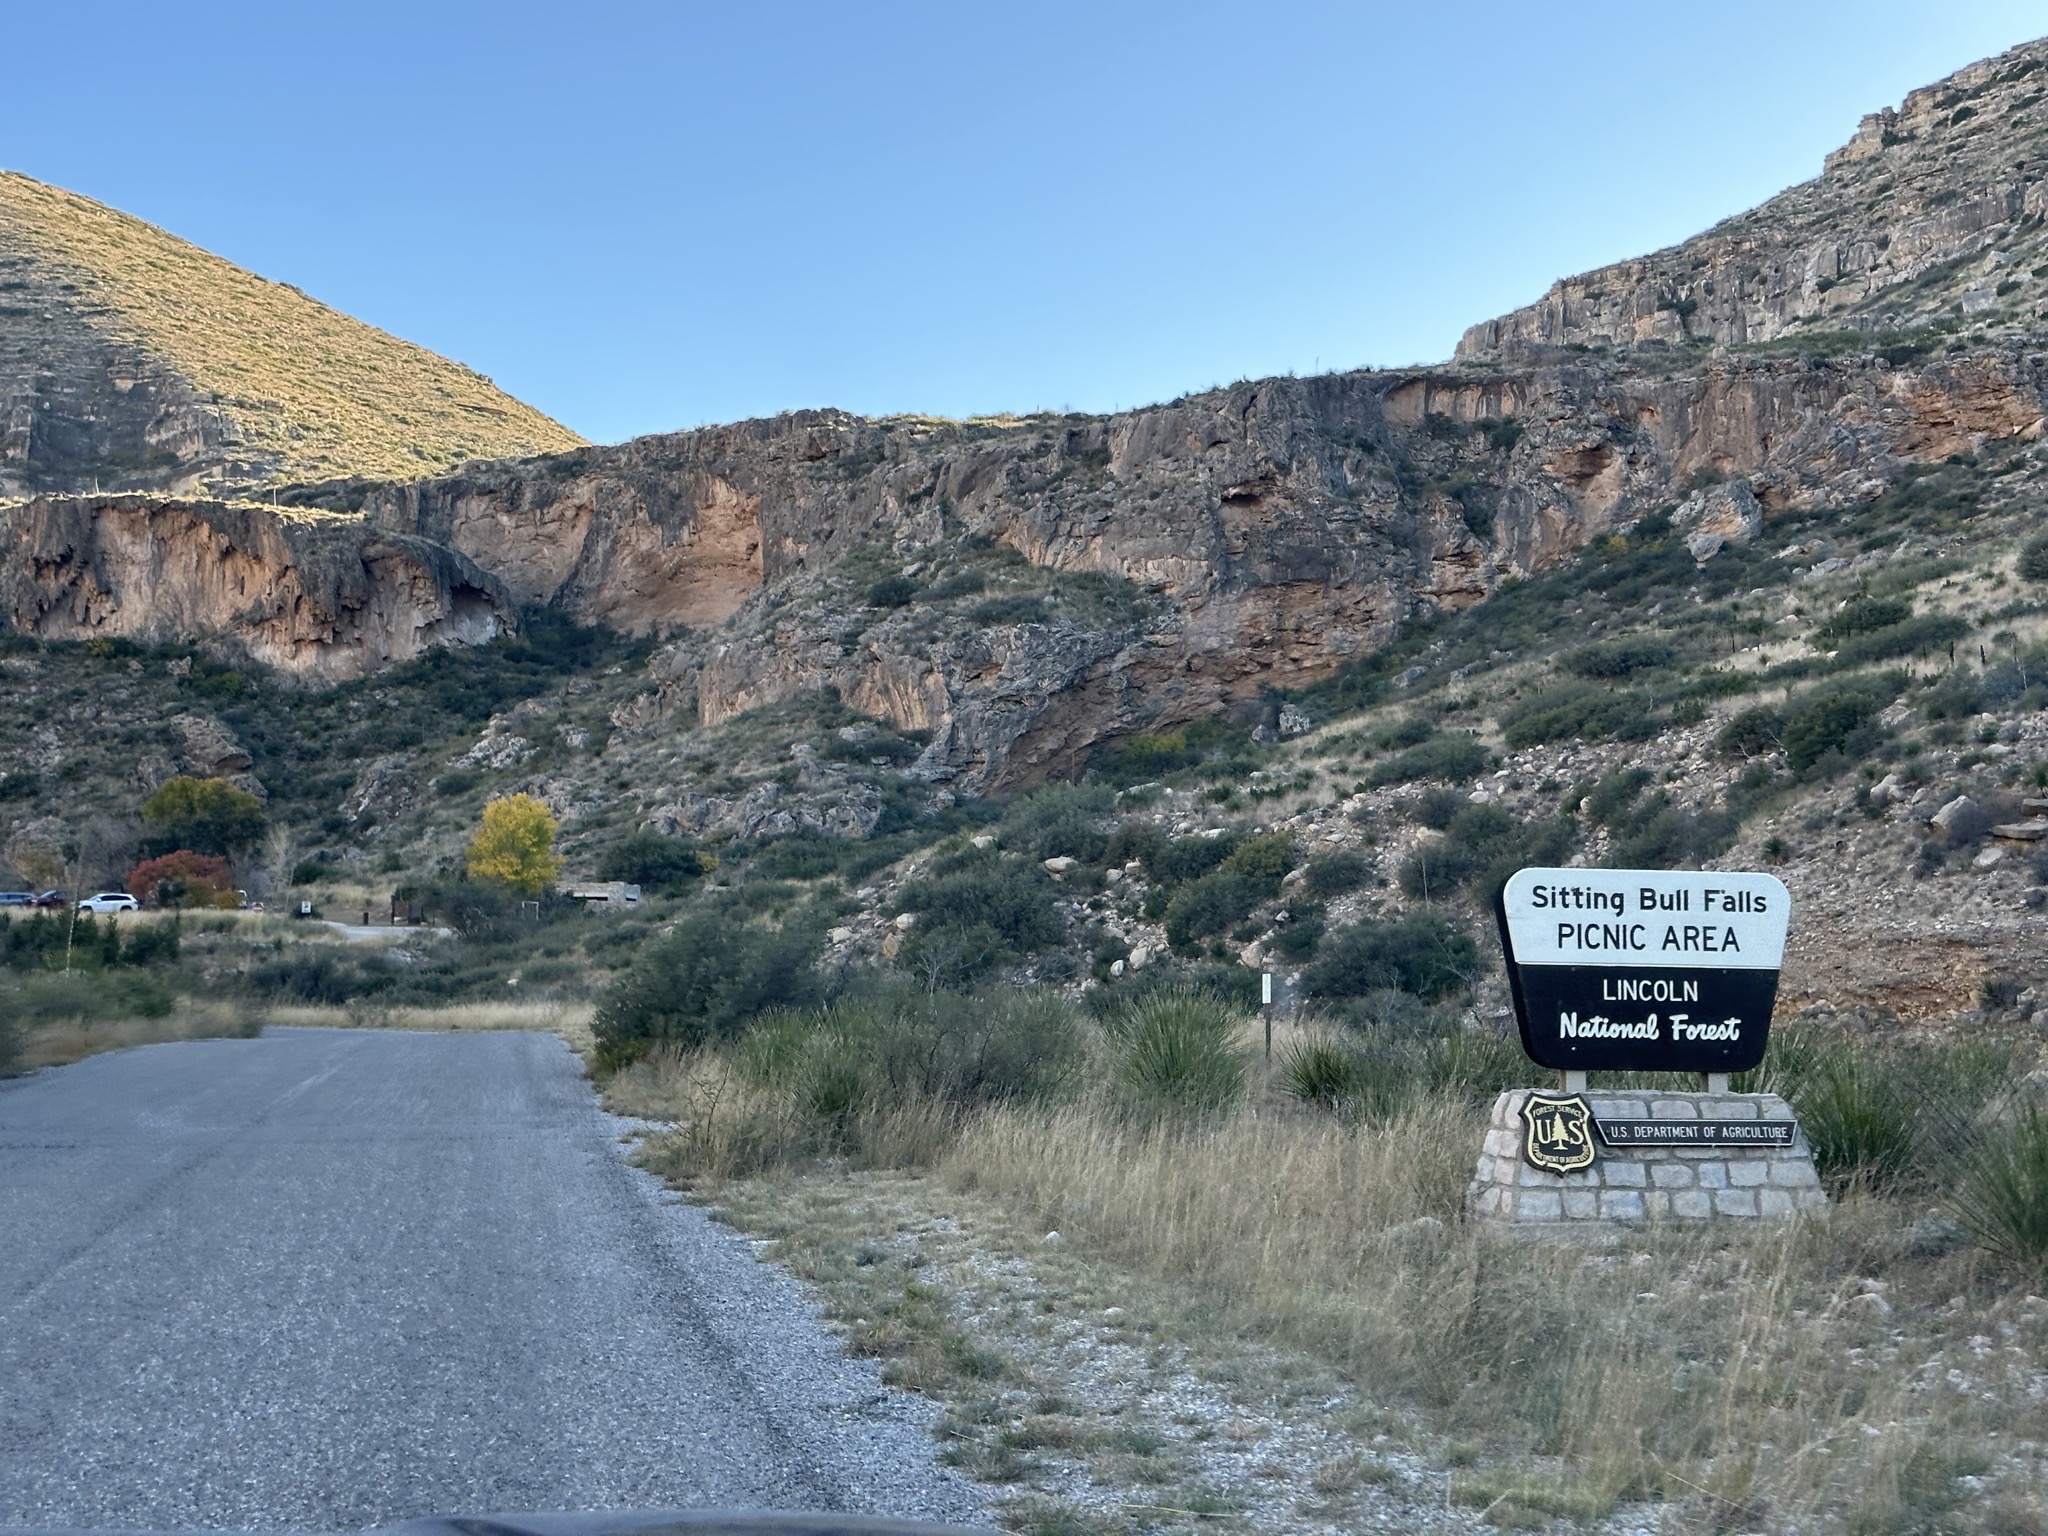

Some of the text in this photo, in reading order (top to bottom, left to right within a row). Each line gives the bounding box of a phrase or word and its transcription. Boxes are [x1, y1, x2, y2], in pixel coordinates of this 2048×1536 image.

[1531, 885, 1767, 917] Sitting Bull Falls
[1558, 922, 1741, 953] PICNIC AREA
[1603, 978, 1698, 1002] LINCOLN
[1559, 1011, 1742, 1041] National Forest
[1533, 1105, 1583, 1119] FOREST SERVICE
[1610, 1126, 1789, 1138] U.S. DEPARTMENT OF AGRICULTURE
